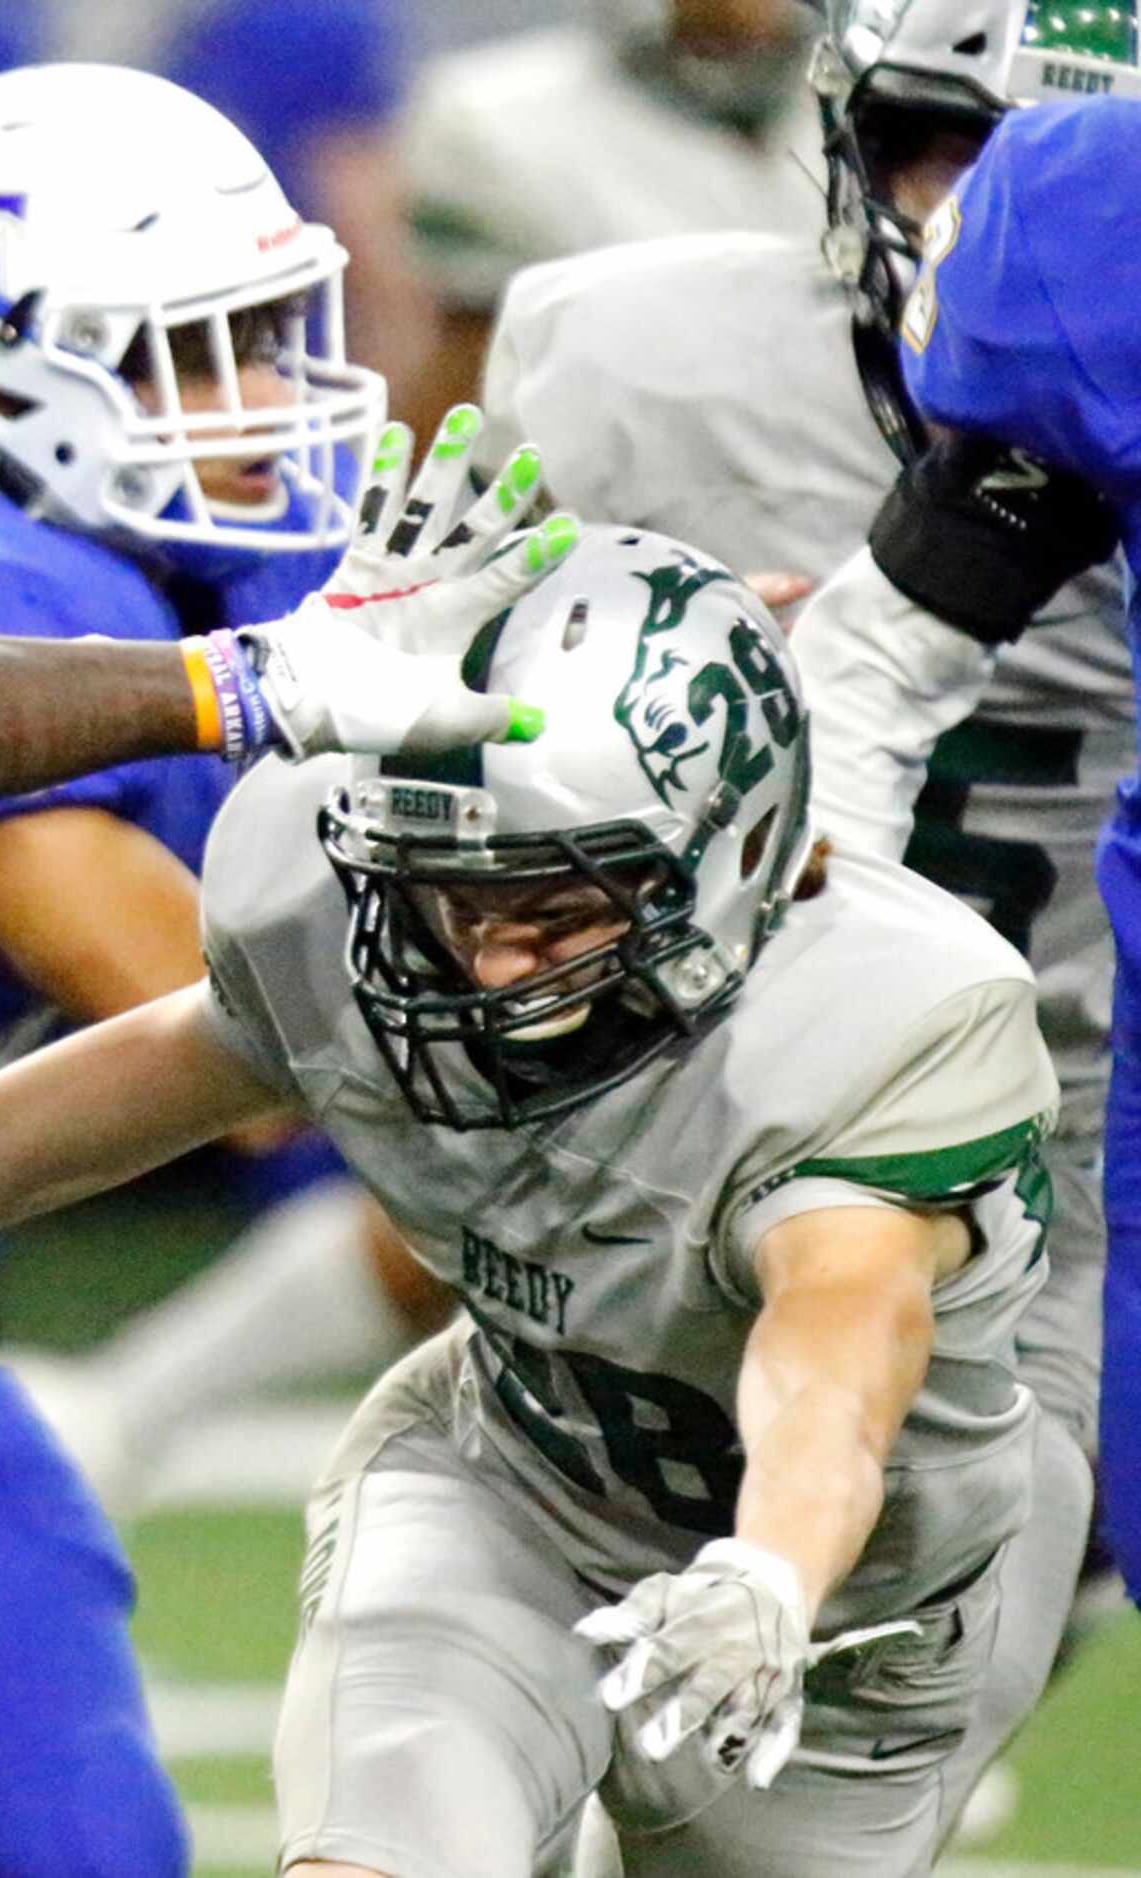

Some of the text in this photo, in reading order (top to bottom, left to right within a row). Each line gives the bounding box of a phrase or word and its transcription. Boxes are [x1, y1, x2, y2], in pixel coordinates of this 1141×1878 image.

[1041, 61, 1116, 95] REEDY
[686, 617, 801, 797] 28
[391, 787, 455, 821] REEDY
[461, 1225, 576, 1337] REEDY
